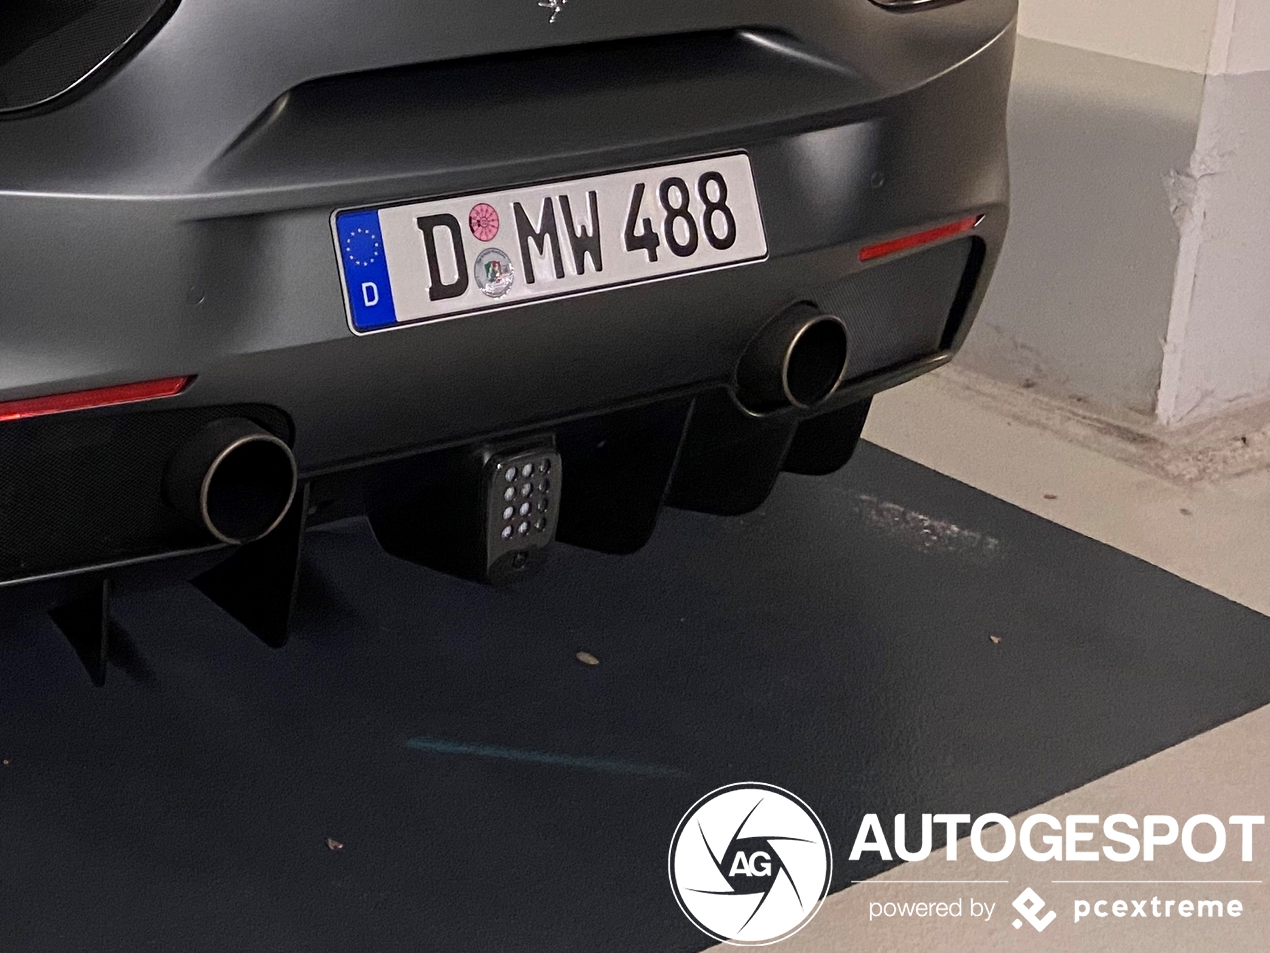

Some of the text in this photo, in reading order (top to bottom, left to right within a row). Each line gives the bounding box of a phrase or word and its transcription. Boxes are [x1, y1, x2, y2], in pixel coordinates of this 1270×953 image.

[417, 213, 469, 301] D
[512, 190, 603, 284] MW
[623, 170, 737, 262] 488
[361, 281, 380, 307] D
